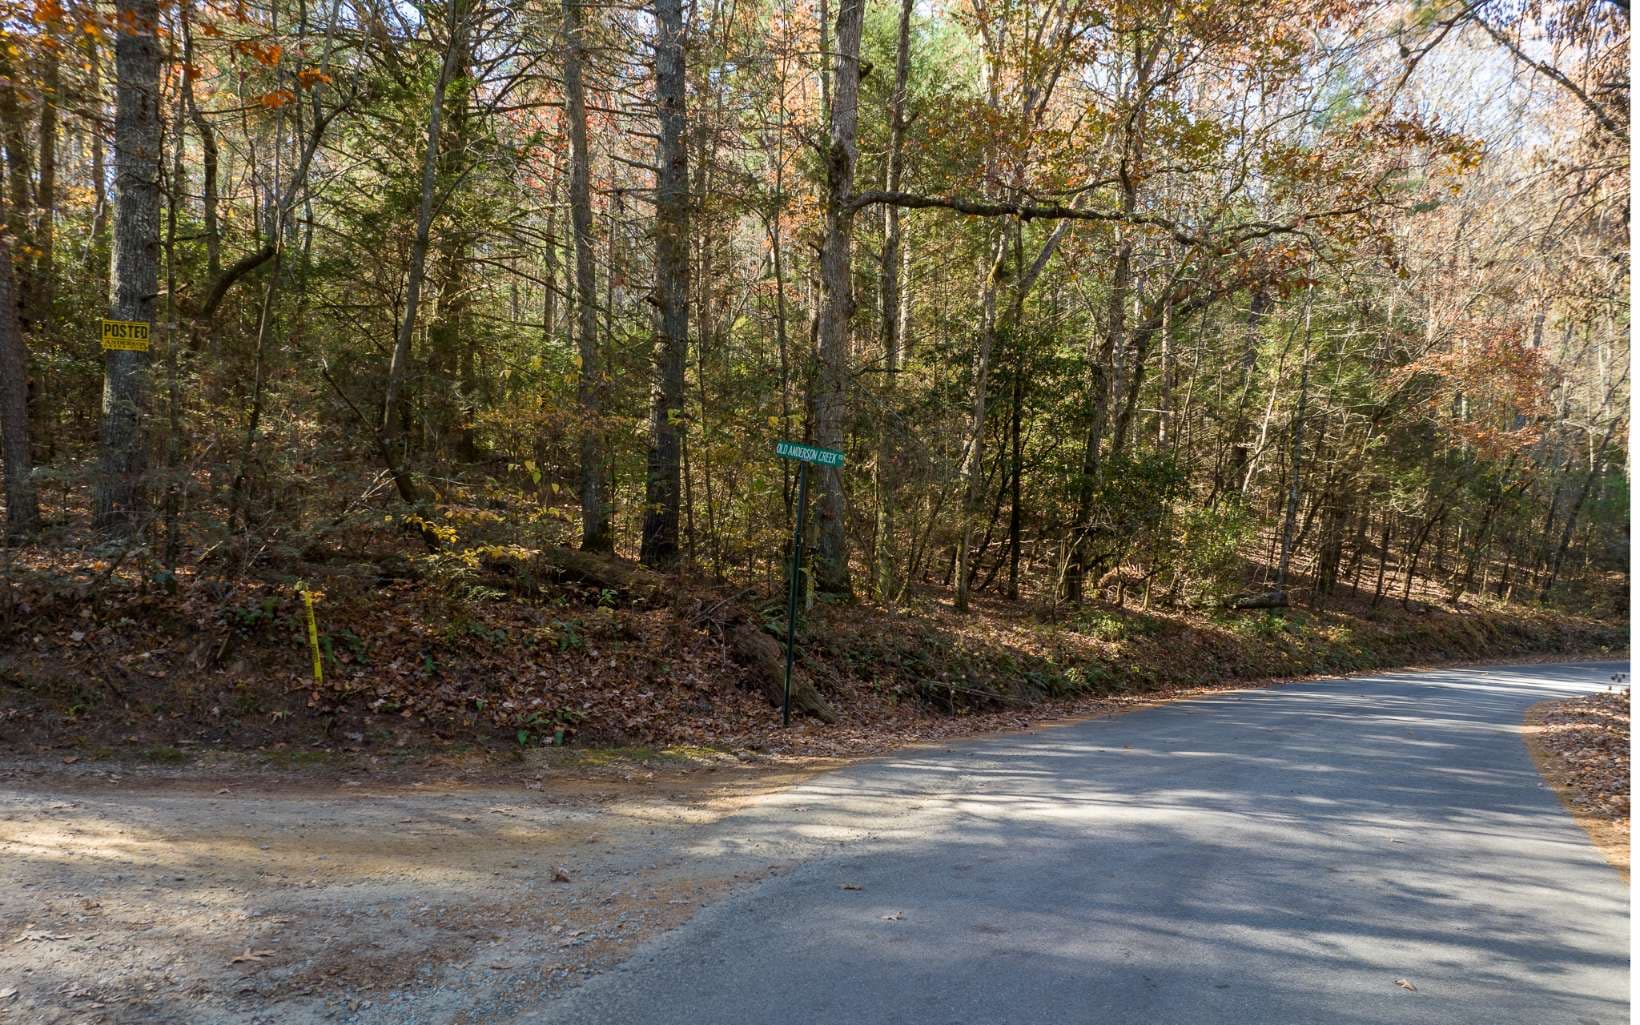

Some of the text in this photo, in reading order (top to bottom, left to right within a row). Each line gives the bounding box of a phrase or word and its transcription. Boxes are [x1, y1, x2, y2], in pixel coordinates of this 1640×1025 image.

[104, 323, 148, 339] POSTED
[776, 443, 837, 464] OLD ANDERSON CREEK
